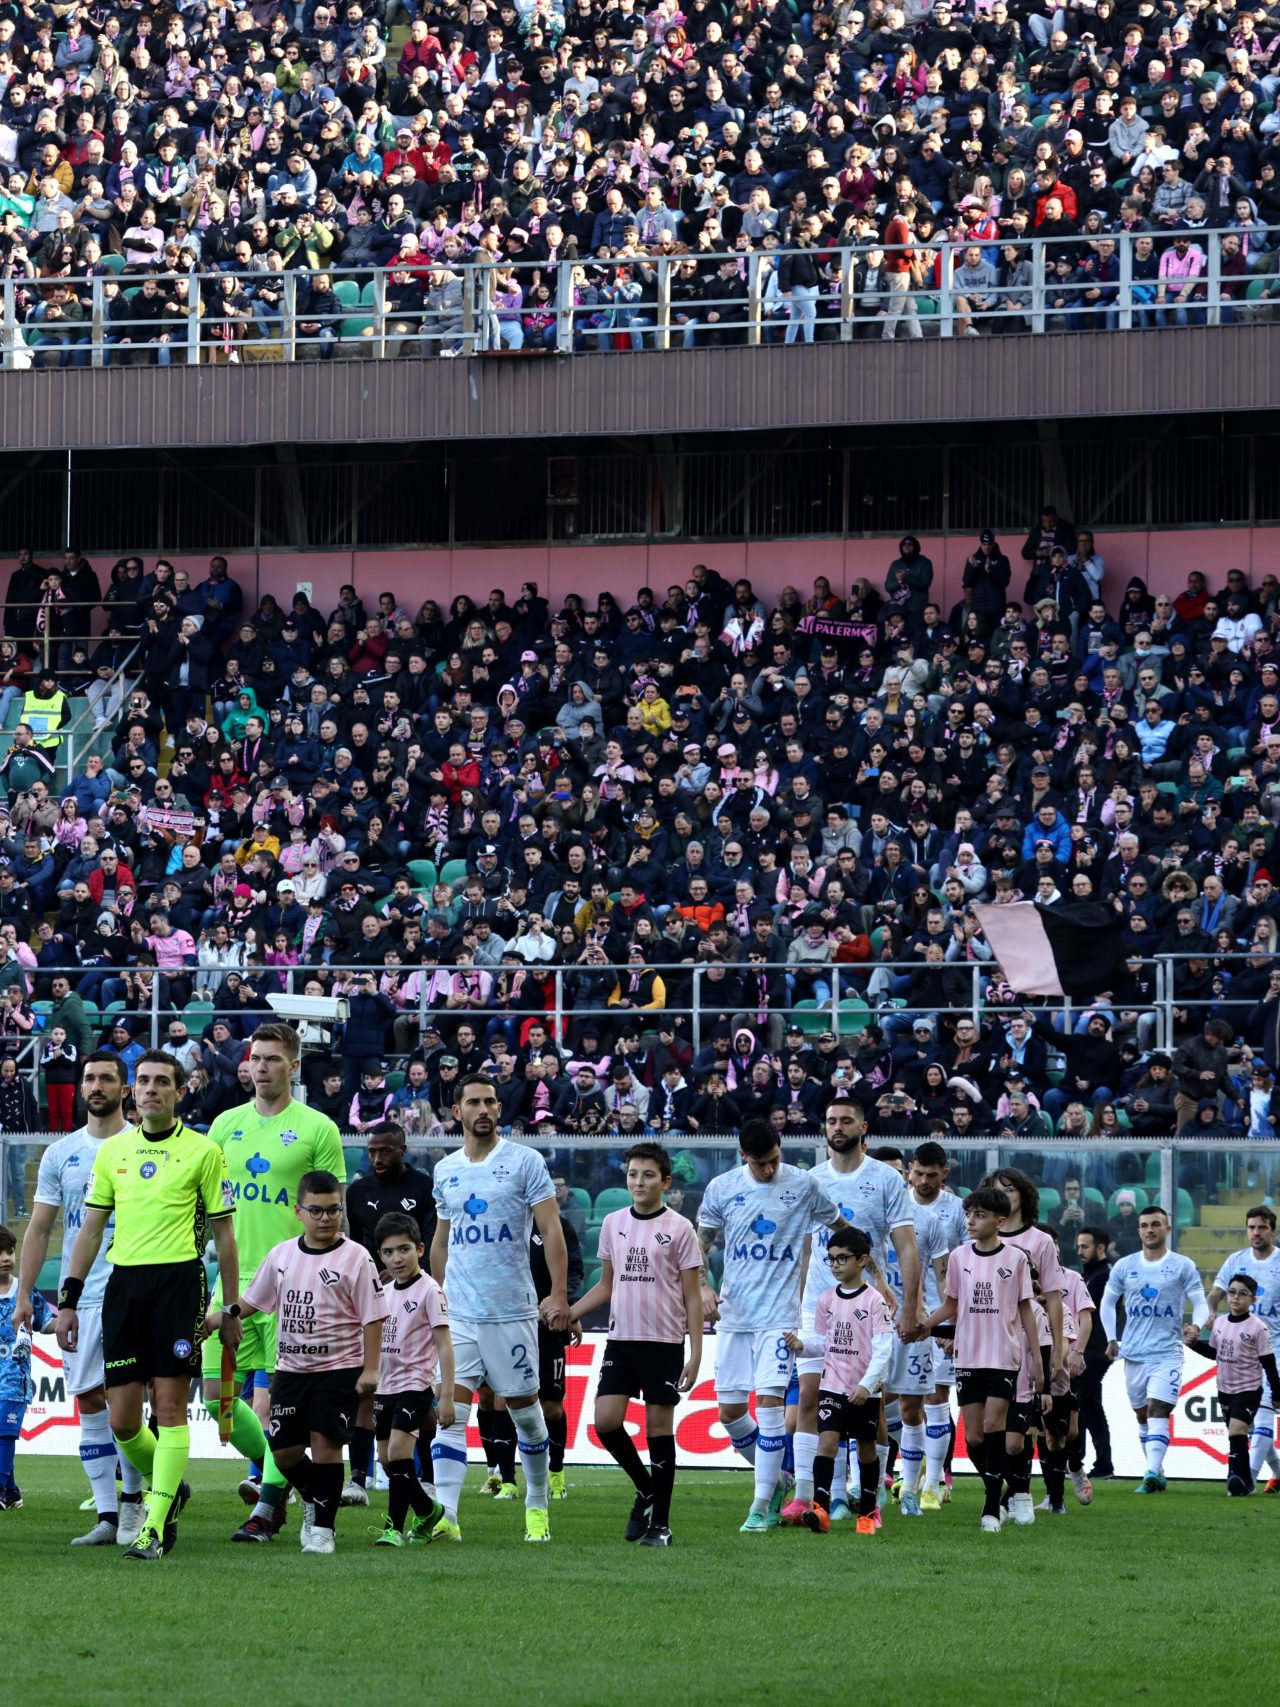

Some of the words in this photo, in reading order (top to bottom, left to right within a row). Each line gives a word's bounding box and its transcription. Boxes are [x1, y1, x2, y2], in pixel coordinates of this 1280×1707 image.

[231, 1182, 289, 1206] MOLA
[452, 1223, 513, 1245] MOLA
[629, 1247, 646, 1255] OLD
[733, 1244, 795, 1262] MOLA
[626, 1255, 649, 1263] WILD
[625, 1264, 650, 1272] WEST
[620, 1274, 655, 1283] Bisaten
[975, 1282, 992, 1290] OLD
[286, 1289, 314, 1305] OLD
[973, 1290, 993, 1298] WILD
[972, 1297, 994, 1305] WEST
[282, 1304, 315, 1319] WILD
[969, 1306, 999, 1314] Bisaten
[1129, 1305, 1174, 1318] MOLA
[281, 1319, 317, 1334] WEST
[836, 1321, 851, 1329] OLD
[834, 1329, 853, 1338] WILD
[279, 1341, 329, 1354] Bisaten
[833, 1337, 854, 1346] WEST
[776, 1337, 790, 1361] 8
[511, 1344, 528, 1370] 2
[553, 1358, 564, 1380] 17
[908, 1353, 932, 1376] 33
[1170, 1370, 1182, 1387] 2
[1184, 1395, 1225, 1423] GD
[760, 1438, 783, 1448] COMO
